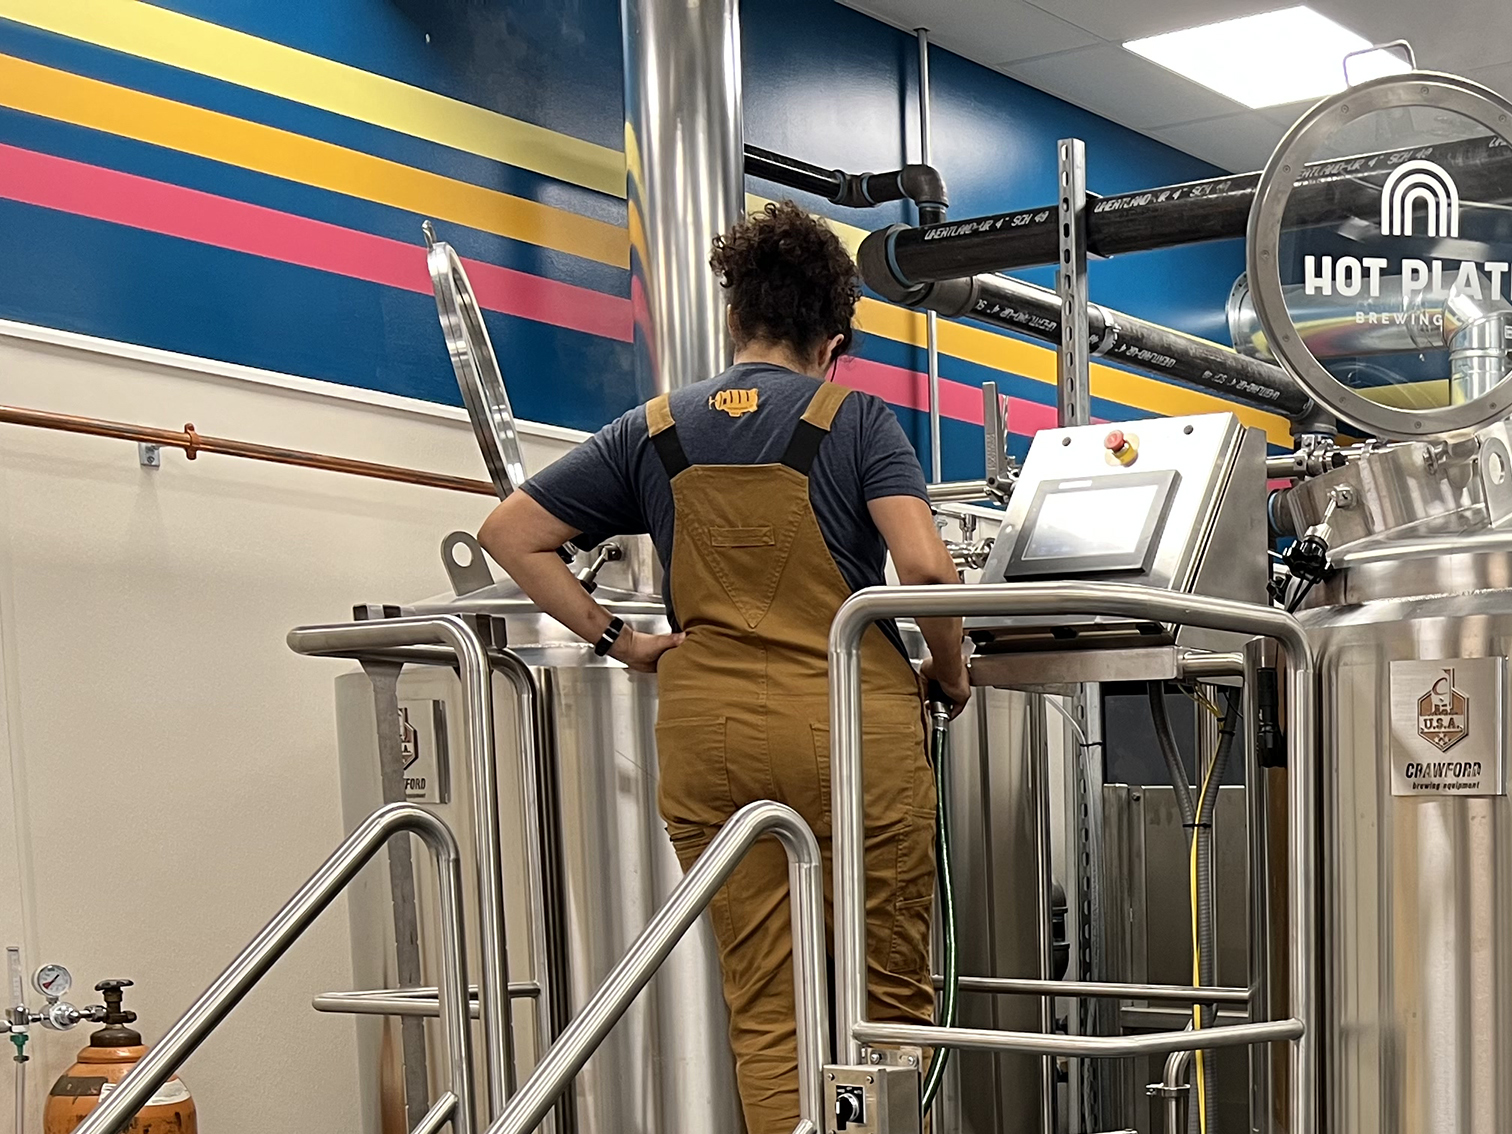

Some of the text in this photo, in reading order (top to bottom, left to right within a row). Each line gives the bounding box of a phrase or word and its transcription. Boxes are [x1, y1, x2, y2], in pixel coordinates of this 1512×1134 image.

[1304, 255, 1388, 297] HOT
[1355, 311, 1443, 325] BREWING
[1423, 717, 1460, 730] U.S.A.
[1405, 761, 1482, 779] CRAWFORD
[405, 777, 427, 790] FORD
[1412, 781, 1480, 791] brewing equipment
